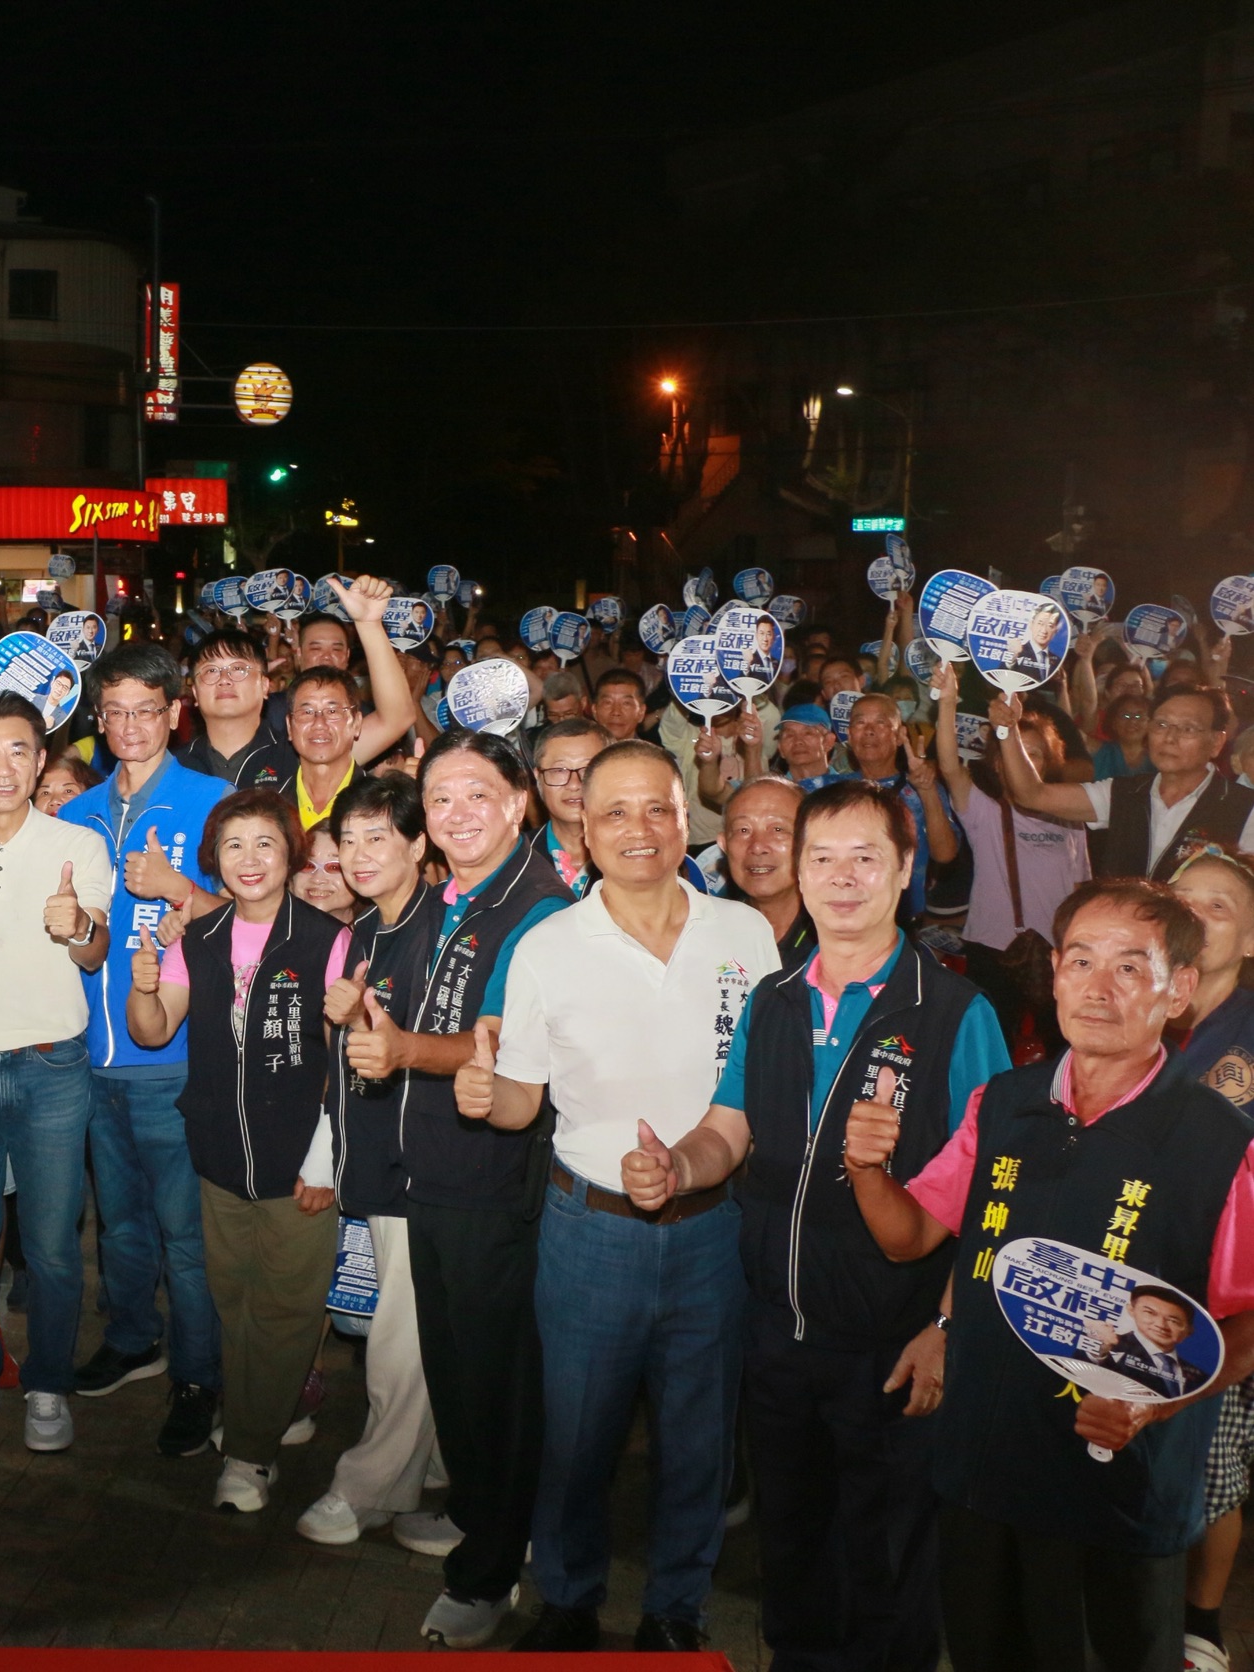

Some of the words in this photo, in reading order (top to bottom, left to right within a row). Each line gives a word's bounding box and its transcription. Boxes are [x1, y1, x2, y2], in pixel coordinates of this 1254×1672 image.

[56, 615, 85, 628] 臺中
[726, 612, 758, 628] 臺中
[972, 615, 1028, 640] 啟程
[50, 630, 81, 642] 啟程
[719, 632, 754, 650] 啟程
[977, 646, 1014, 664] 江啟臣
[672, 658, 717, 674] 啟程
[871, 1048, 913, 1067] 臺中市政府
[972, 1155, 1022, 1282] 張坤山
[1027, 1239, 1137, 1293] 臺中
[1003, 1254, 1028, 1268] MAKE
[1031, 1264, 1074, 1285] TAICHUNG
[1077, 1282, 1100, 1295] BEST
[1103, 1292, 1127, 1304] EVER
[1002, 1264, 1127, 1329] 啟程
[1023, 1315, 1104, 1356] 江啟臣
